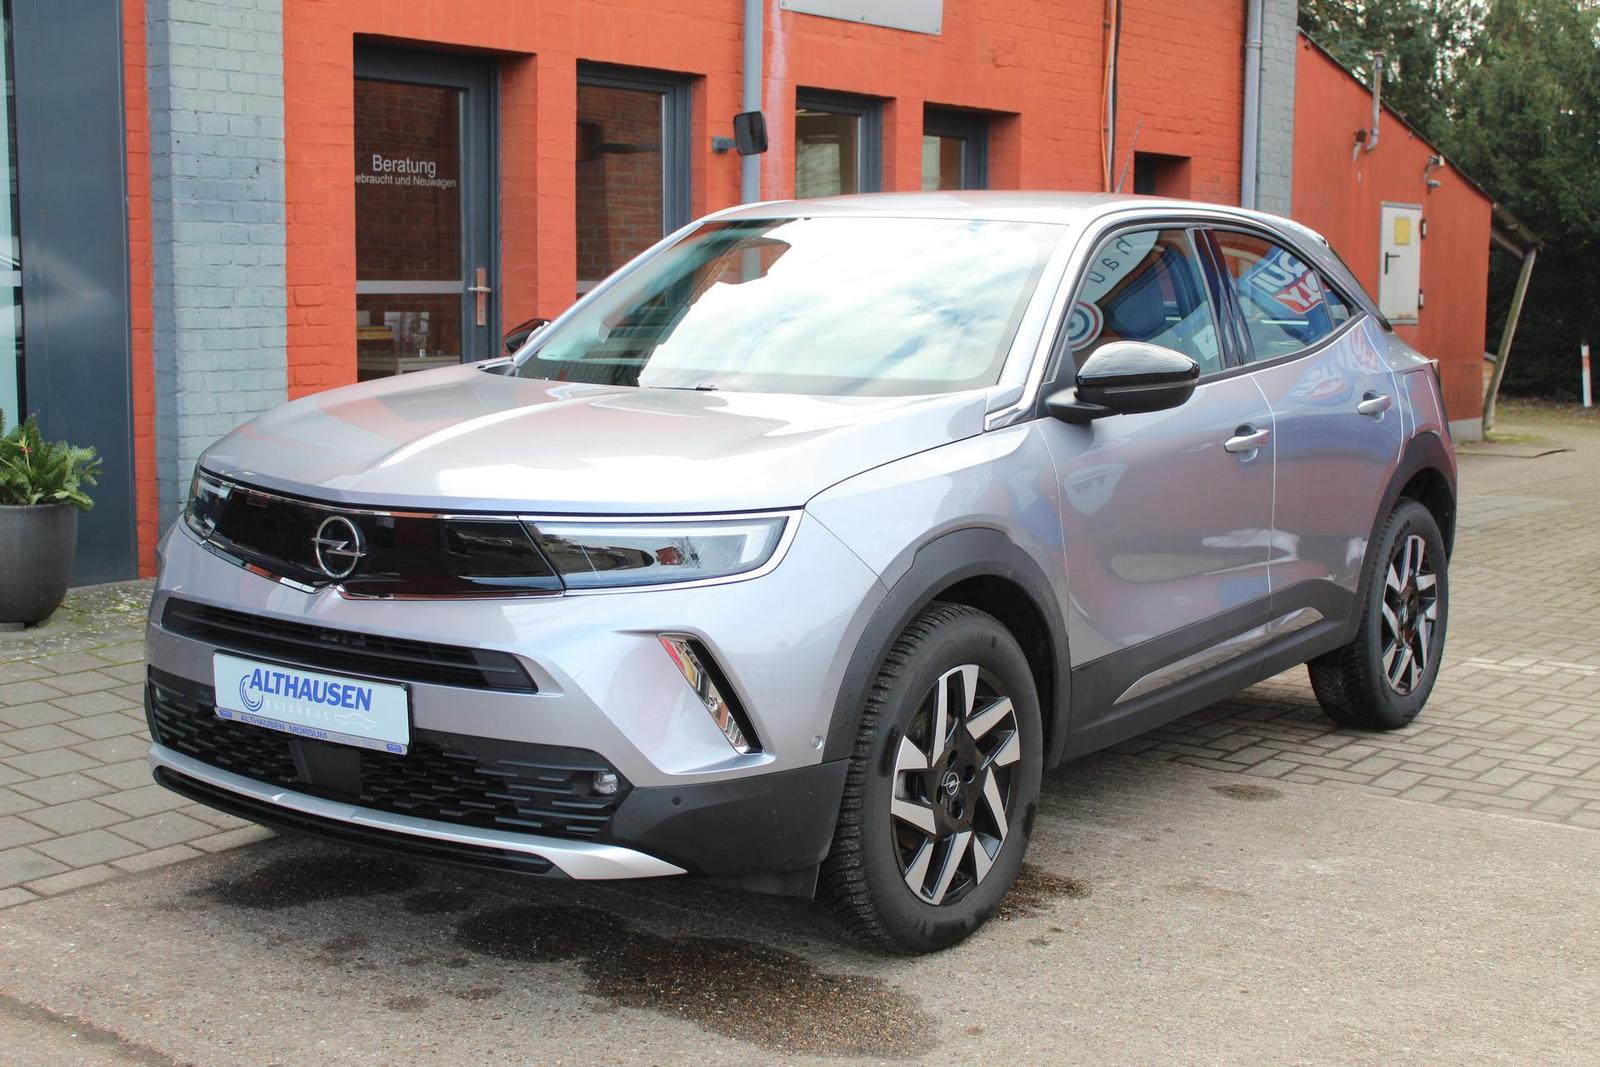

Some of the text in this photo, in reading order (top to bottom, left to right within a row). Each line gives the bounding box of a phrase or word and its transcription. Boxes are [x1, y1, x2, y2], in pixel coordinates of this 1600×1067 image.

[372, 154, 436, 178] Beratung
[355, 172, 457, 189] ebraucht und Neuwagen
[249, 667, 373, 712] ALTHAUSEN
[240, 714, 287, 731] ALTHAUSEN
